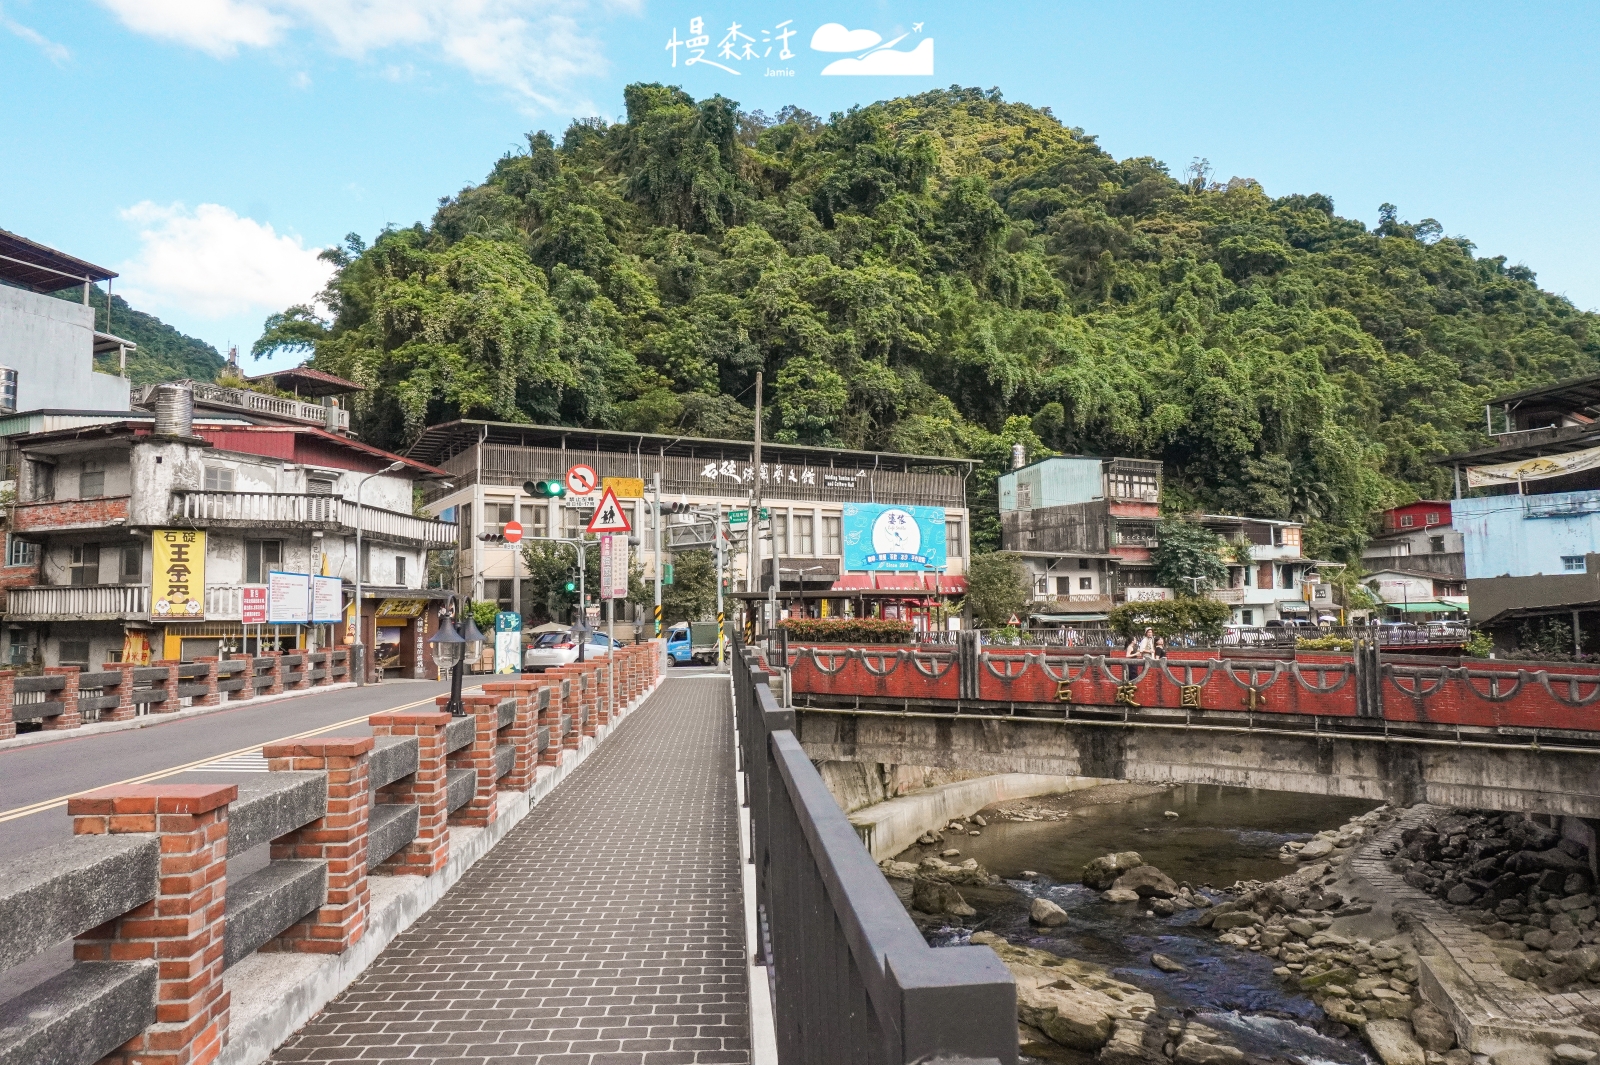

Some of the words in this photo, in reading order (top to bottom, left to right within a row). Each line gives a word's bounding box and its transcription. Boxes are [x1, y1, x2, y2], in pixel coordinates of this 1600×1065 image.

[164, 531, 196, 543] 石碇
[166, 543, 192, 604] 王金蛋
